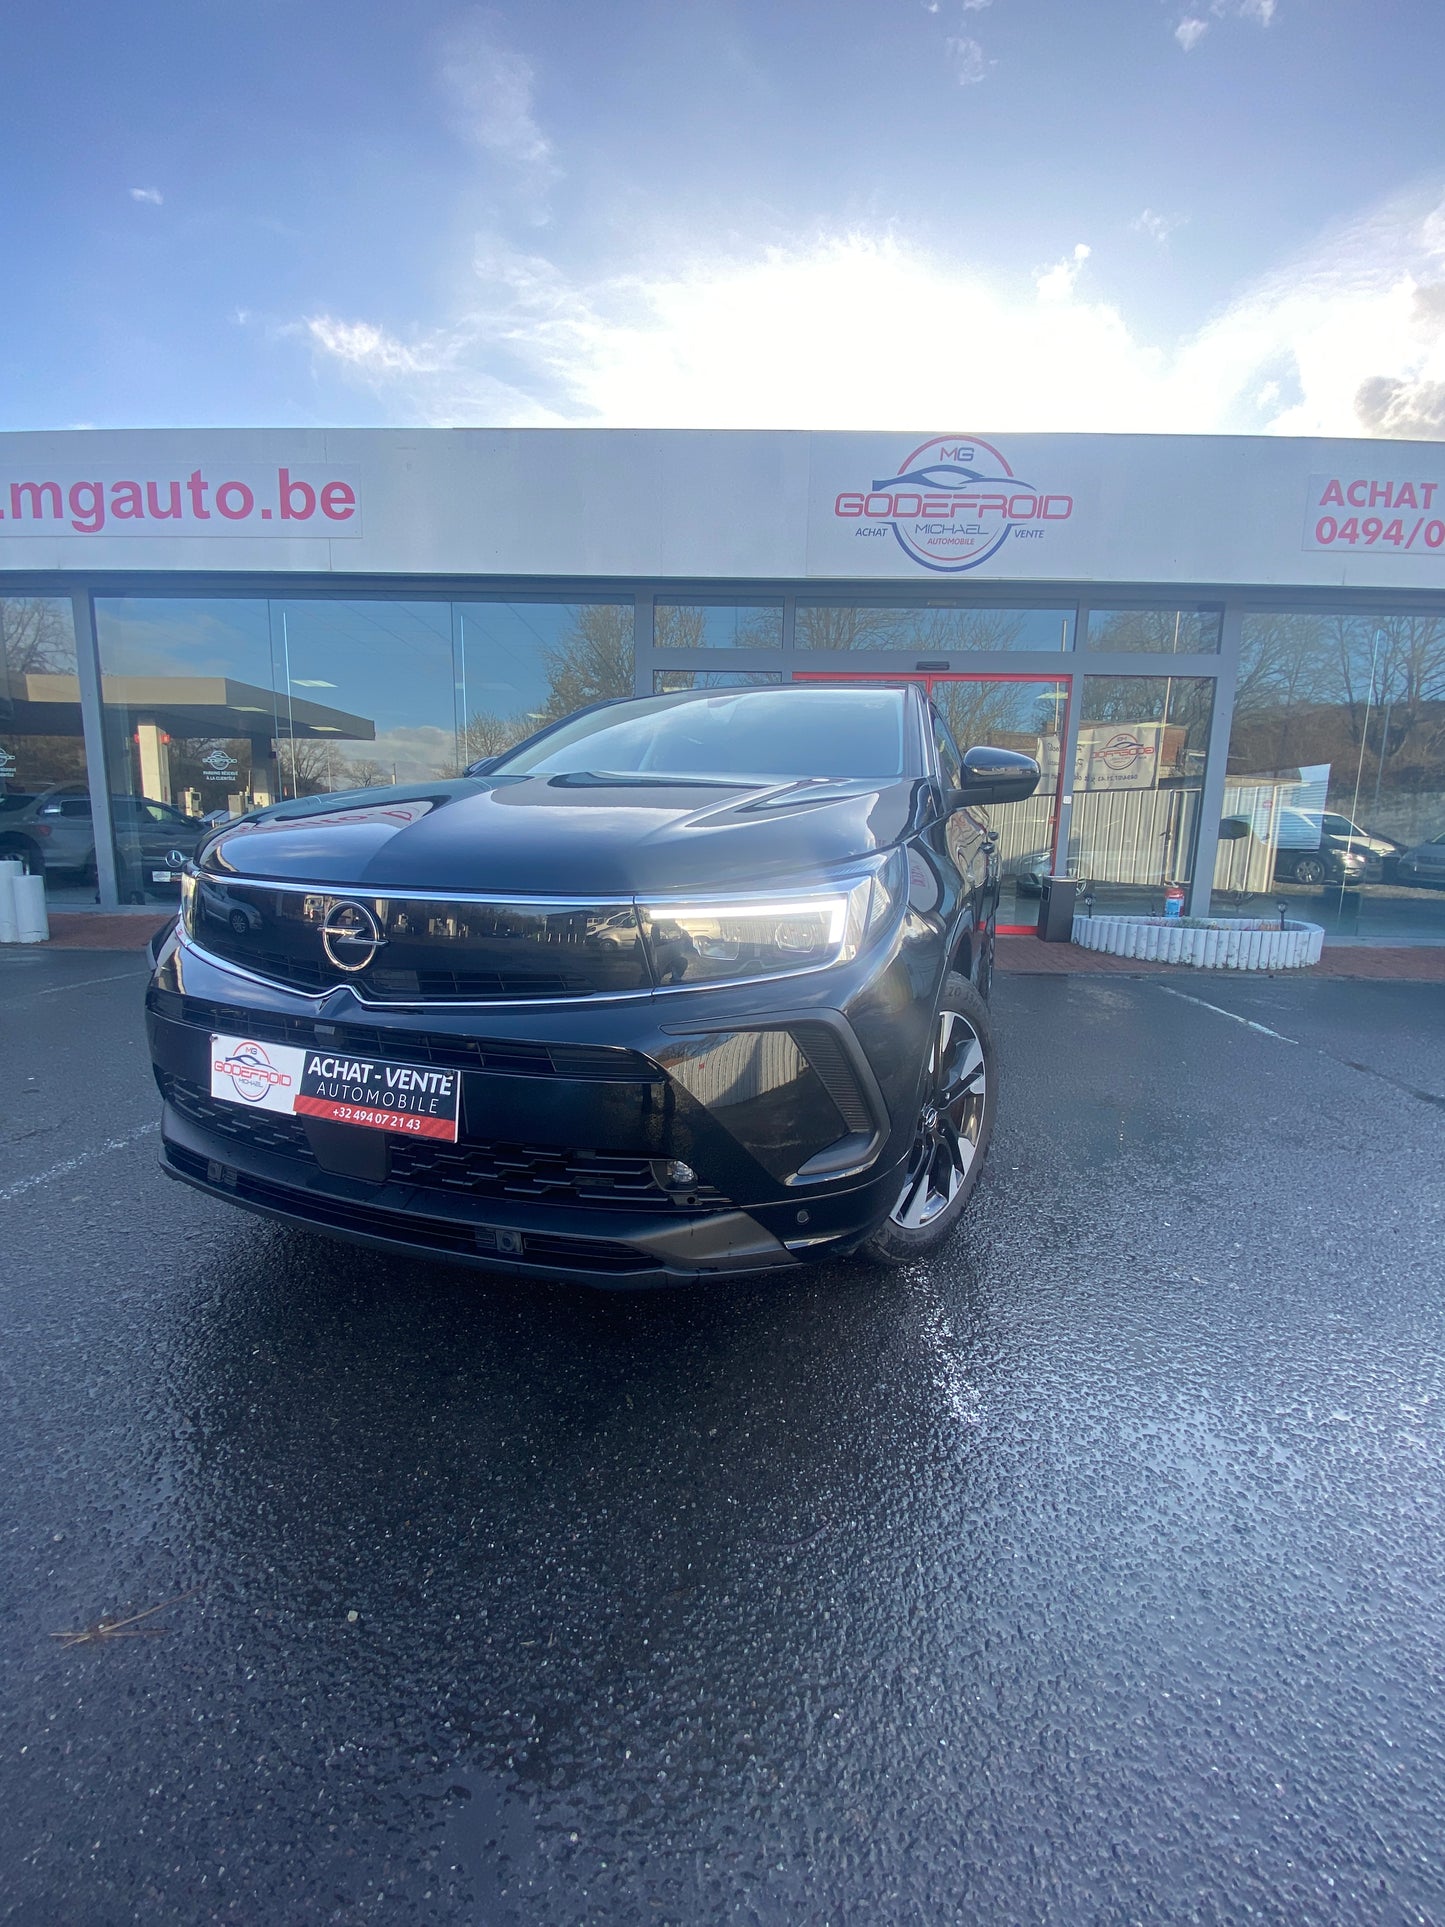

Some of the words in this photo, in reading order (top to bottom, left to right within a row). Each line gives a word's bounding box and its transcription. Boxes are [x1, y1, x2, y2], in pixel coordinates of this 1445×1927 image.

[939, 447, 975, 462] MG
[1318, 479, 1438, 509] ACHAT
[834, 492, 1073, 520] GODEFROID
[855, 528, 888, 537] ACHAT
[914, 523, 990, 535] MICHAEL
[1014, 529, 1045, 539] VENTE
[1315, 516, 1445, 549] 0494/0
[927, 537, 976, 546] AUTOMOBILE
[245, 1047, 258, 1055] MG
[214, 1060, 292, 1087] GODEFROID
[308, 1056, 374, 1083] ACHAT
[385, 1067, 454, 1096] VENTE
[316, 1081, 440, 1114] AUTOMOBILE
[332, 1107, 351, 1119] +32
[353, 1110, 373, 1123] 494
[375, 1113, 390, 1124] 07
[390, 1115, 404, 1128] 21
[406, 1118, 421, 1130] 43
